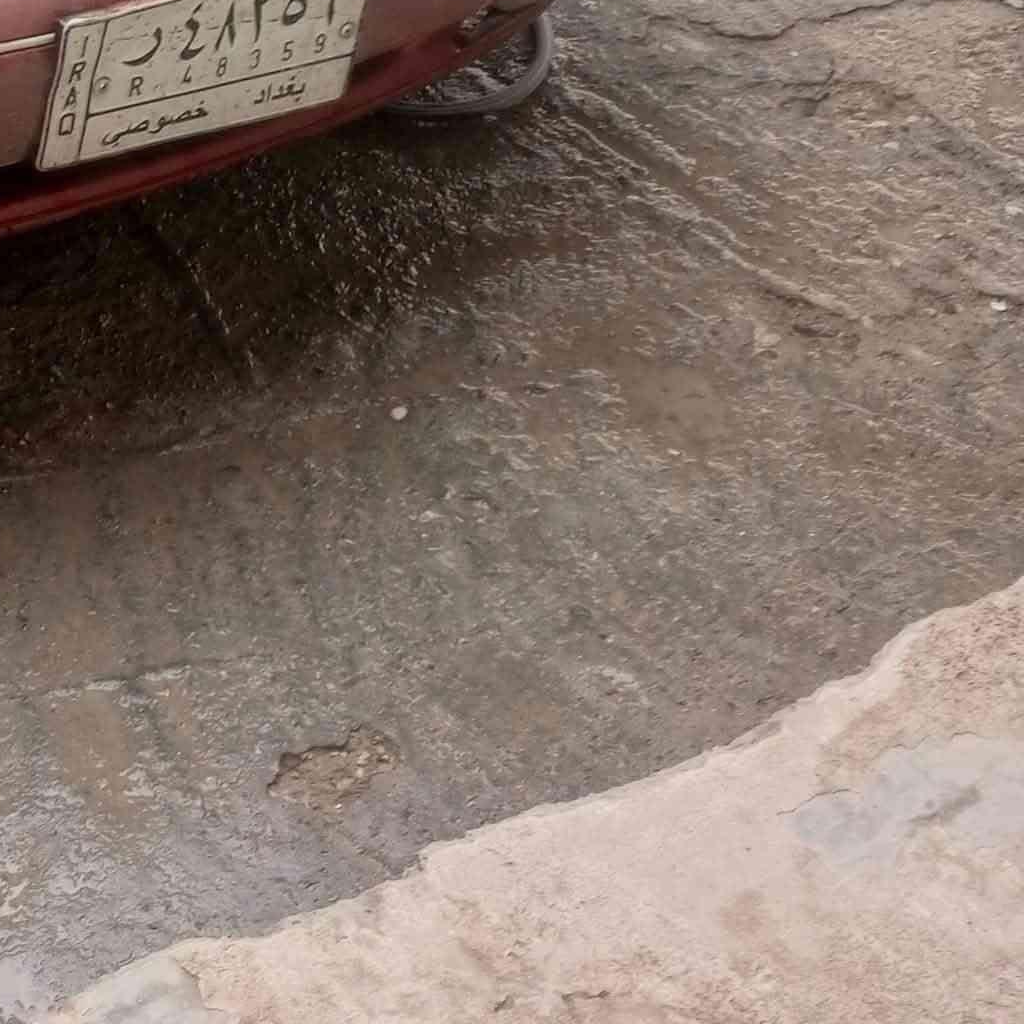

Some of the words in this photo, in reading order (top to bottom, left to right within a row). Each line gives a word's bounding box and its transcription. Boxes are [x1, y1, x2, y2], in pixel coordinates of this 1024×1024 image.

[59, 35, 88, 136] IRAQ
[128, 76, 144, 96] R
[181, 33, 327, 84] 48359
[254, 76, 305, 105] بغداد
[102, 103, 208, 146] خصوصي
